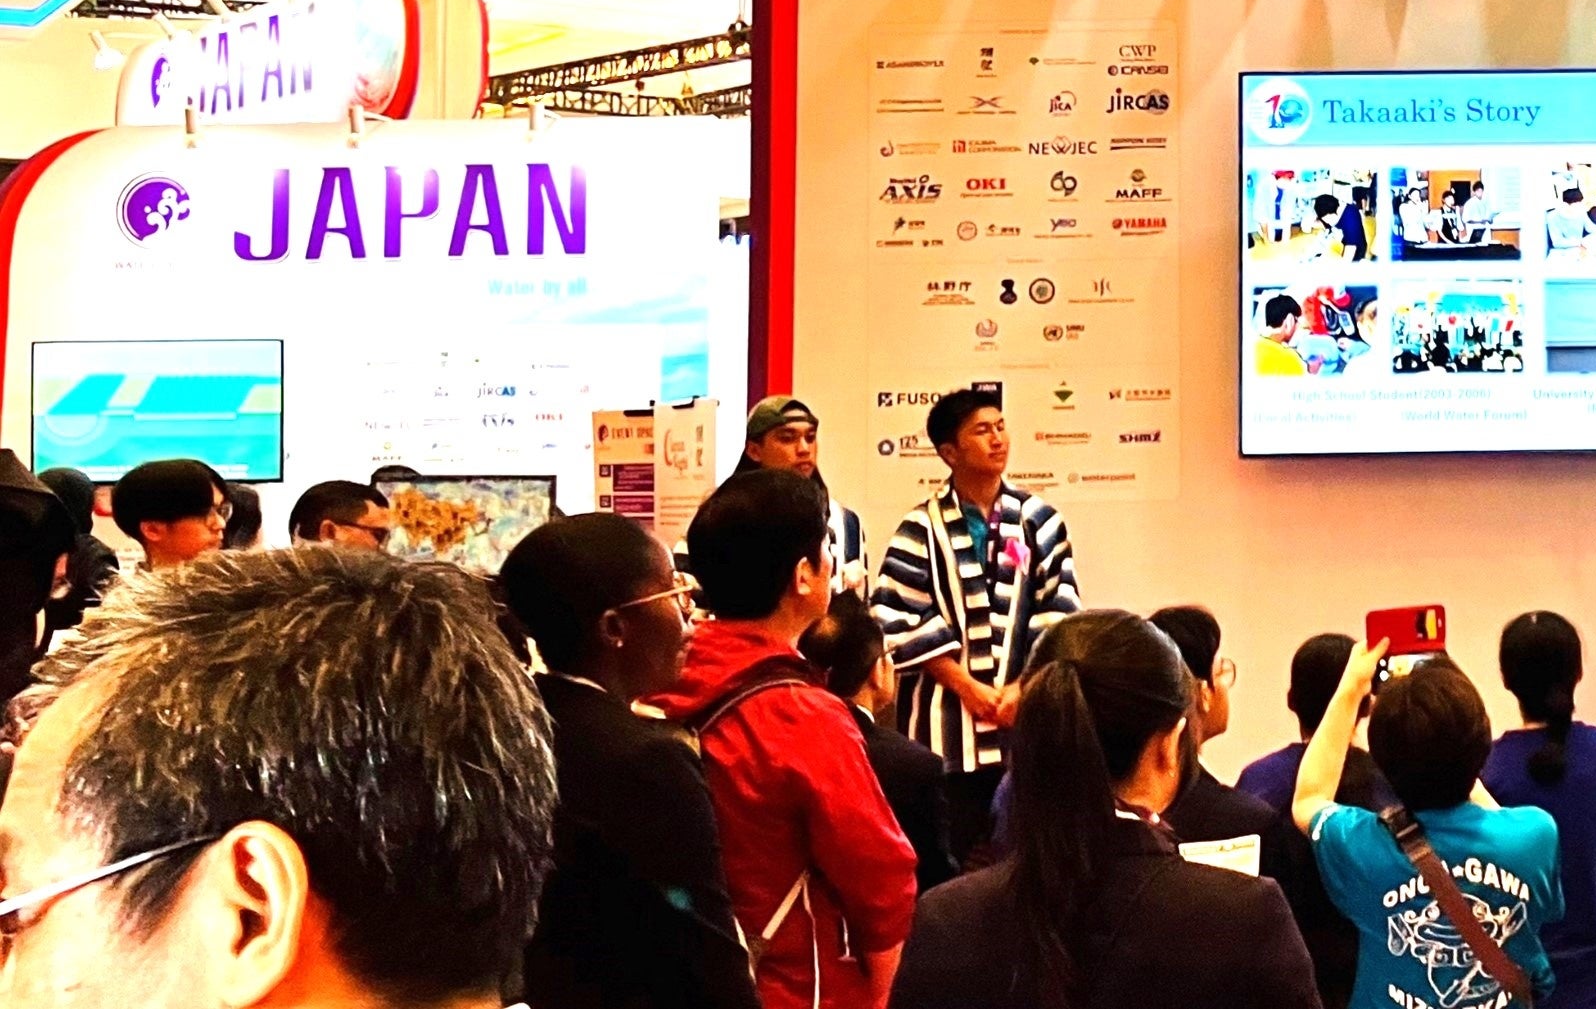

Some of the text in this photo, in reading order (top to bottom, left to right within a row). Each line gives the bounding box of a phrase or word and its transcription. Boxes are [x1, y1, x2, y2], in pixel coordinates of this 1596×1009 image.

[1119, 45, 1157, 58] CWP
[1322, 97, 1541, 127] Takaaki's Story
[966, 178, 1006, 190] OKI
[1116, 189, 1162, 198] MAFF
[233, 163, 589, 265] JAPAN
[1124, 217, 1167, 229] YAMAHA
